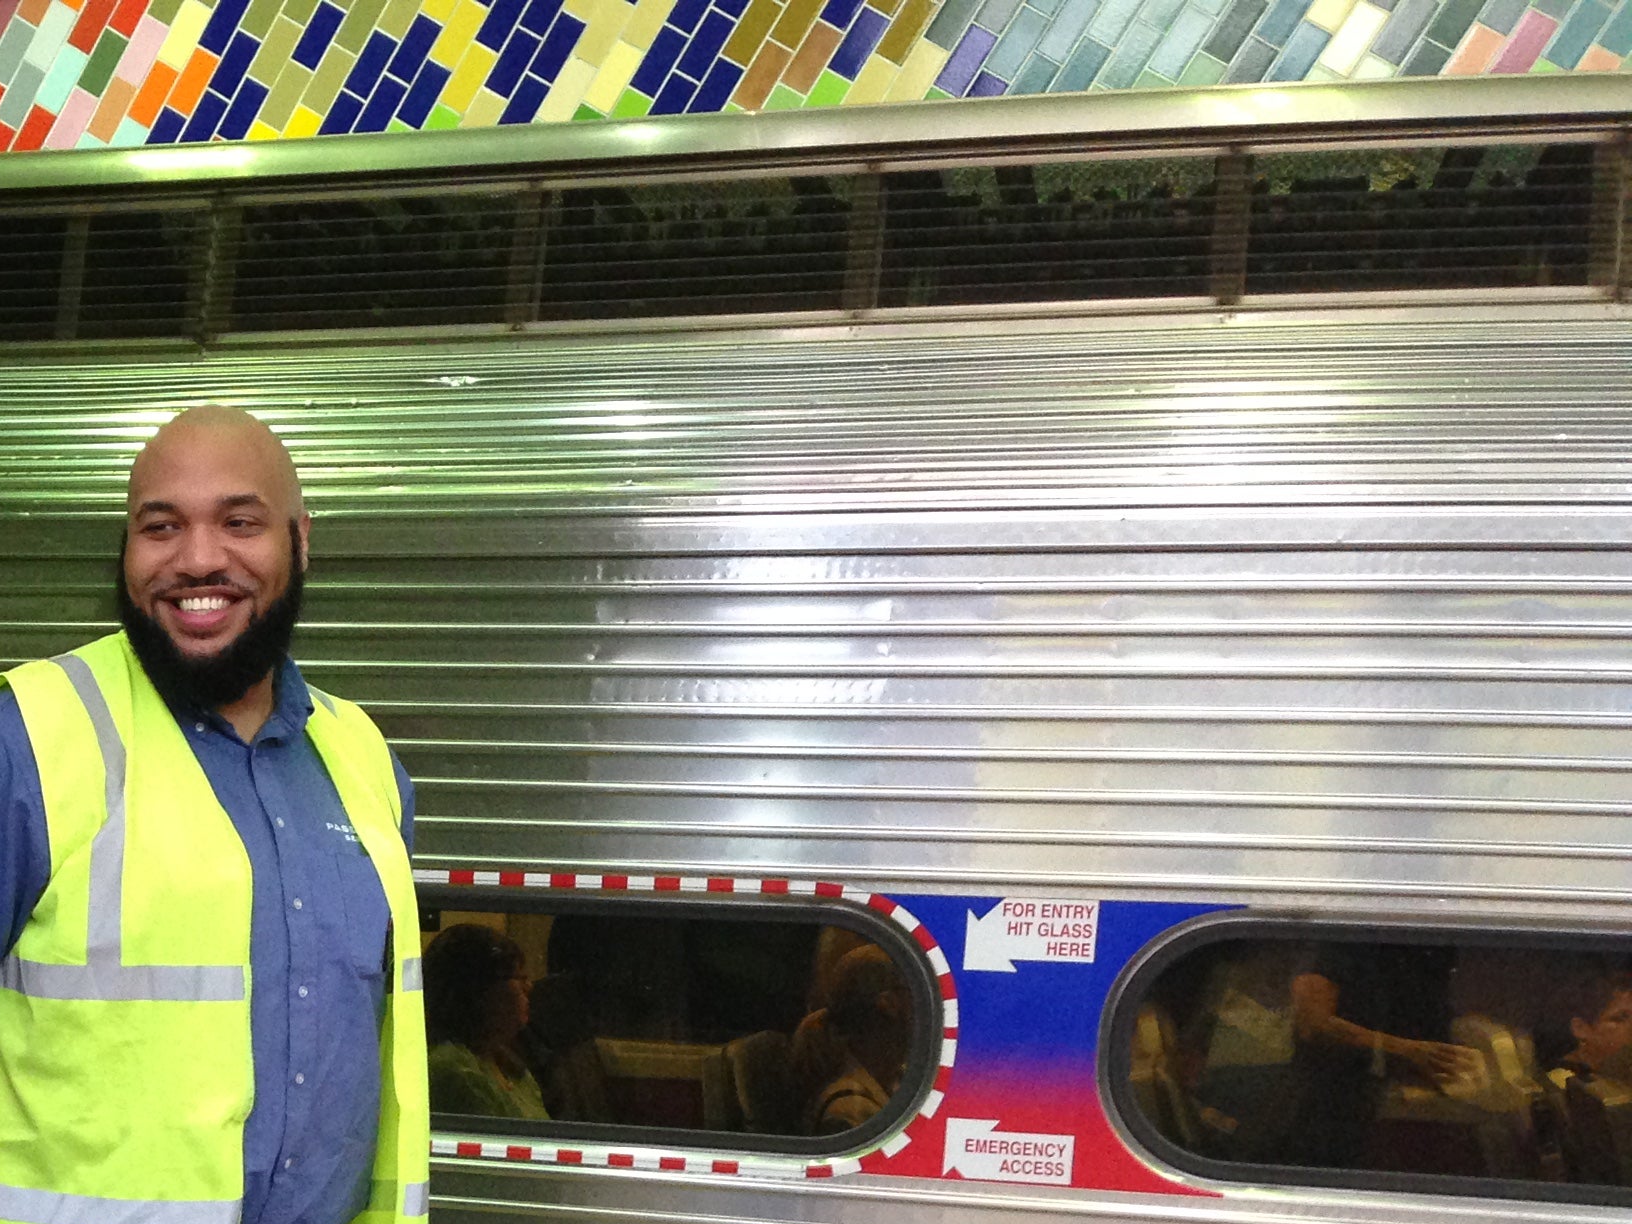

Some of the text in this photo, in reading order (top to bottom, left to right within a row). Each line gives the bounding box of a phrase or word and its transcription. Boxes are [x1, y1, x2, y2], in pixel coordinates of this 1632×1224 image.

[1003, 902, 1095, 919] FOR ENTRY
[1007, 921, 1093, 939] HIT GLASS
[1047, 942, 1091, 957] HERE
[965, 1138, 1067, 1158] EMERGENCY
[999, 1159, 1065, 1177] ACCESS
